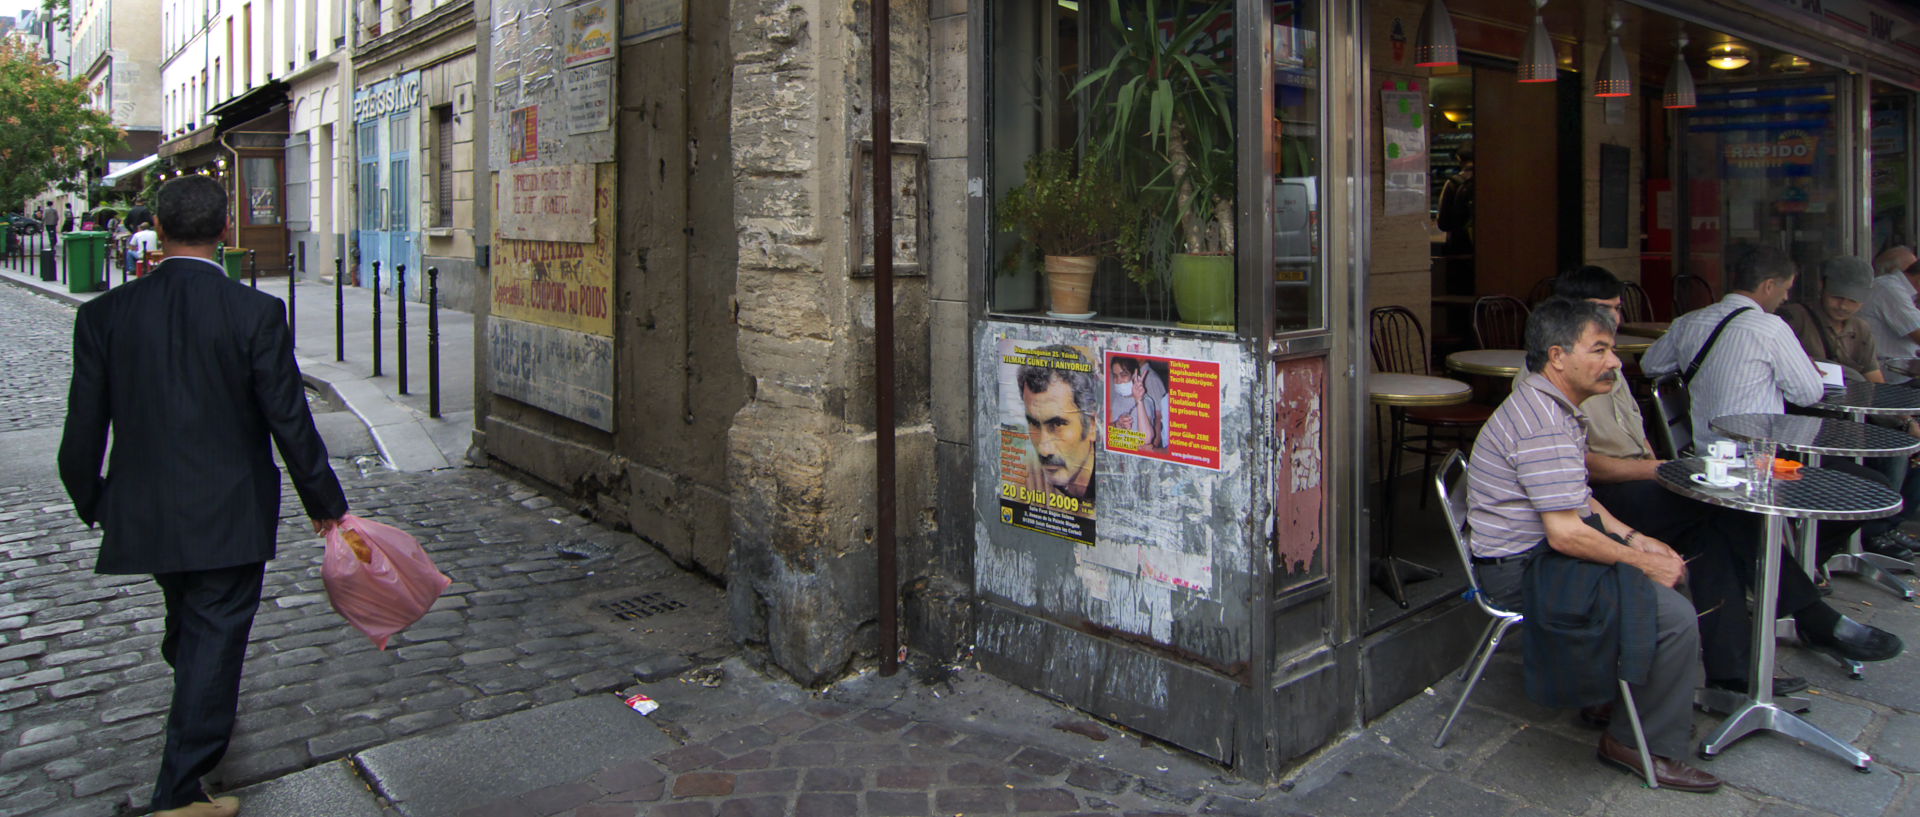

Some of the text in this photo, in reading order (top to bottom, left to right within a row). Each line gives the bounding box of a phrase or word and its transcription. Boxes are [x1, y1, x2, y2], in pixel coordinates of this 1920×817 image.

[354, 80, 419, 122] PRESSING
[1731, 144, 1808, 159] RAPIDO
[531, 279, 567, 313] COUPONS
[579, 285, 608, 320] POIDS
[1003, 355, 1026, 365] YILMAZ
[1055, 361, 1092, 372] ANIYORUZ!
[1170, 360, 1190, 369] Türkiye
[1177, 389, 1198, 400] Turquie
[1170, 398, 1211, 409] l'isolation dans
[1177, 407, 1198, 417] prisons
[1199, 410, 1210, 419] tue.
[1170, 420, 1188, 430] Liberté
[1170, 431, 1209, 441] pour Güler ZERE
[1170, 438, 1188, 448] victime
[1003, 483, 1079, 512] 20 Eylül 2009
